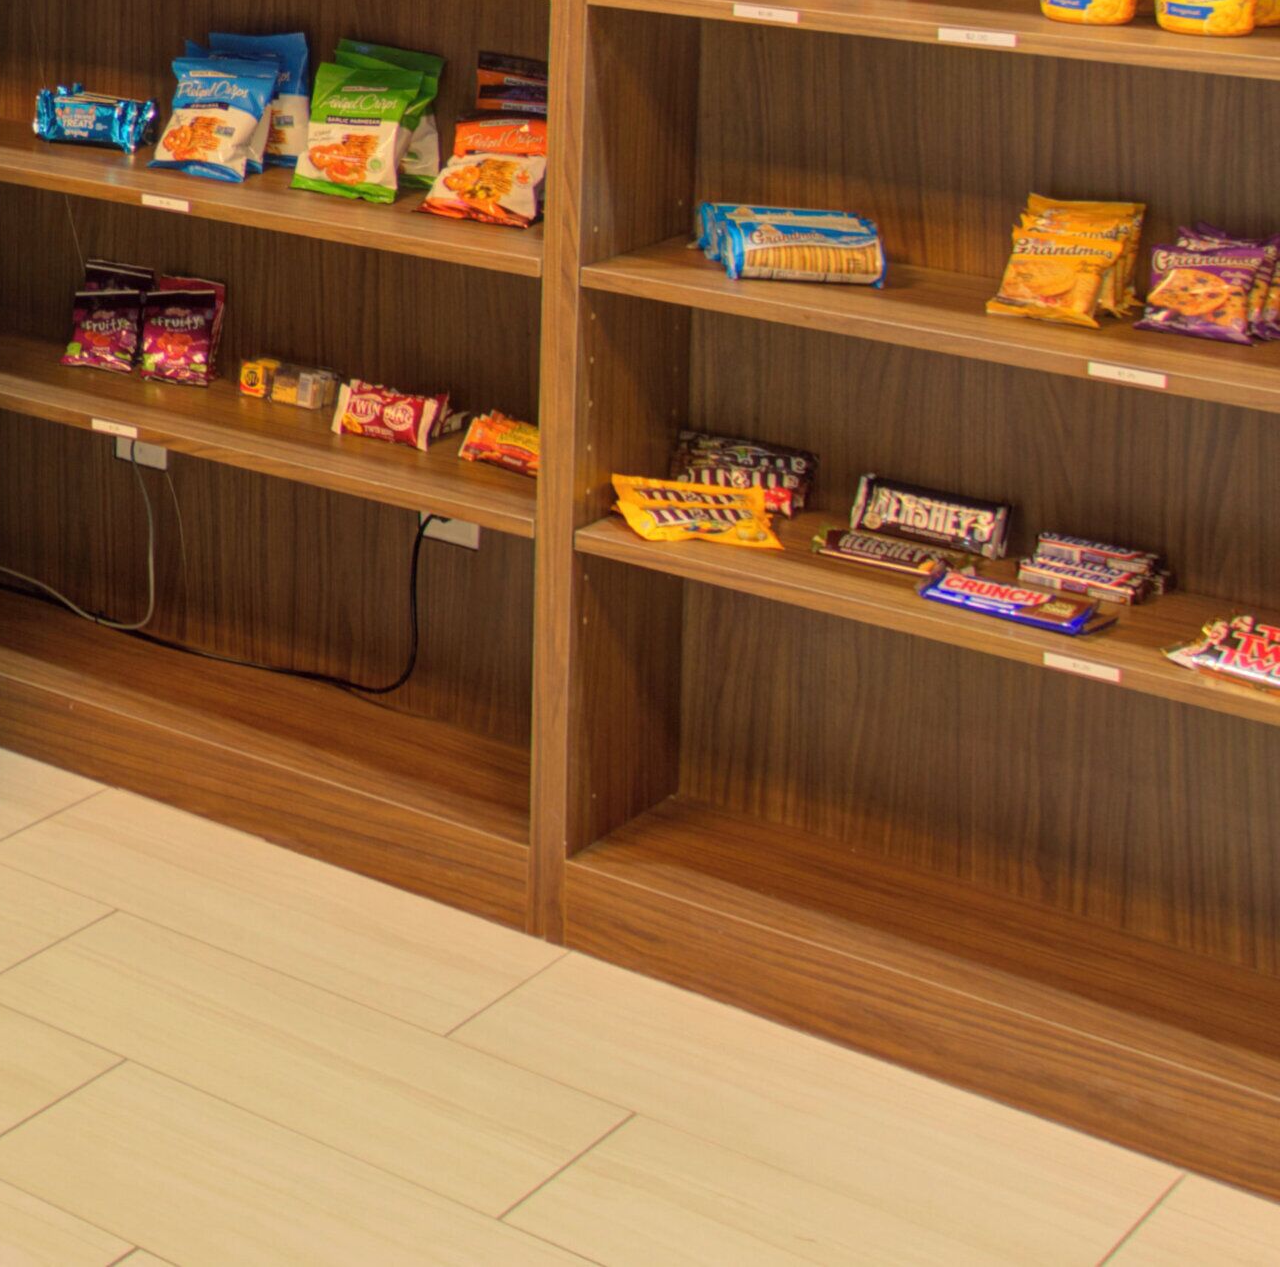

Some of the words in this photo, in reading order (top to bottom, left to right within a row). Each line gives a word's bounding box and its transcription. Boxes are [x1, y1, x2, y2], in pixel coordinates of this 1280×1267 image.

[177, 81, 215, 100] Pretzel
[214, 80, 249, 99] Crisps
[359, 93, 398, 112] Crisps
[349, 395, 381, 416] TWIN
[873, 486, 996, 542] HERSHEY'S
[944, 575, 1044, 605] CRUNCH
